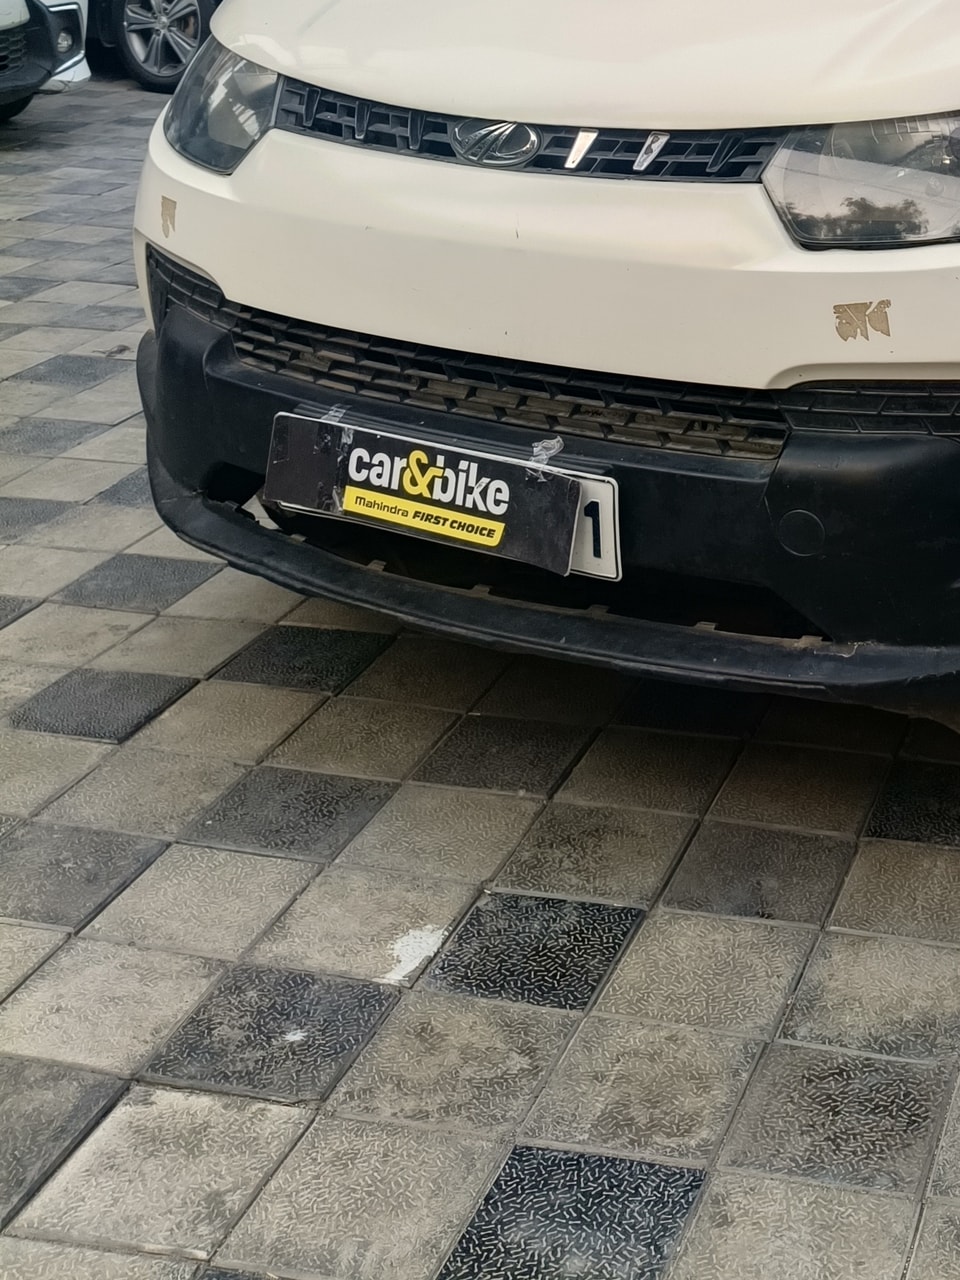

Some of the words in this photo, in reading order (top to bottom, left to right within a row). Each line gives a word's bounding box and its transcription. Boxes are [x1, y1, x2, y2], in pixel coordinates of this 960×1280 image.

[348, 447, 510, 516] car&bike
[354, 494, 409, 518] Mahindra
[412, 509, 450, 528] FIRST
[450, 518, 496, 539] CHOICE
[583, 499, 602, 559] 1
